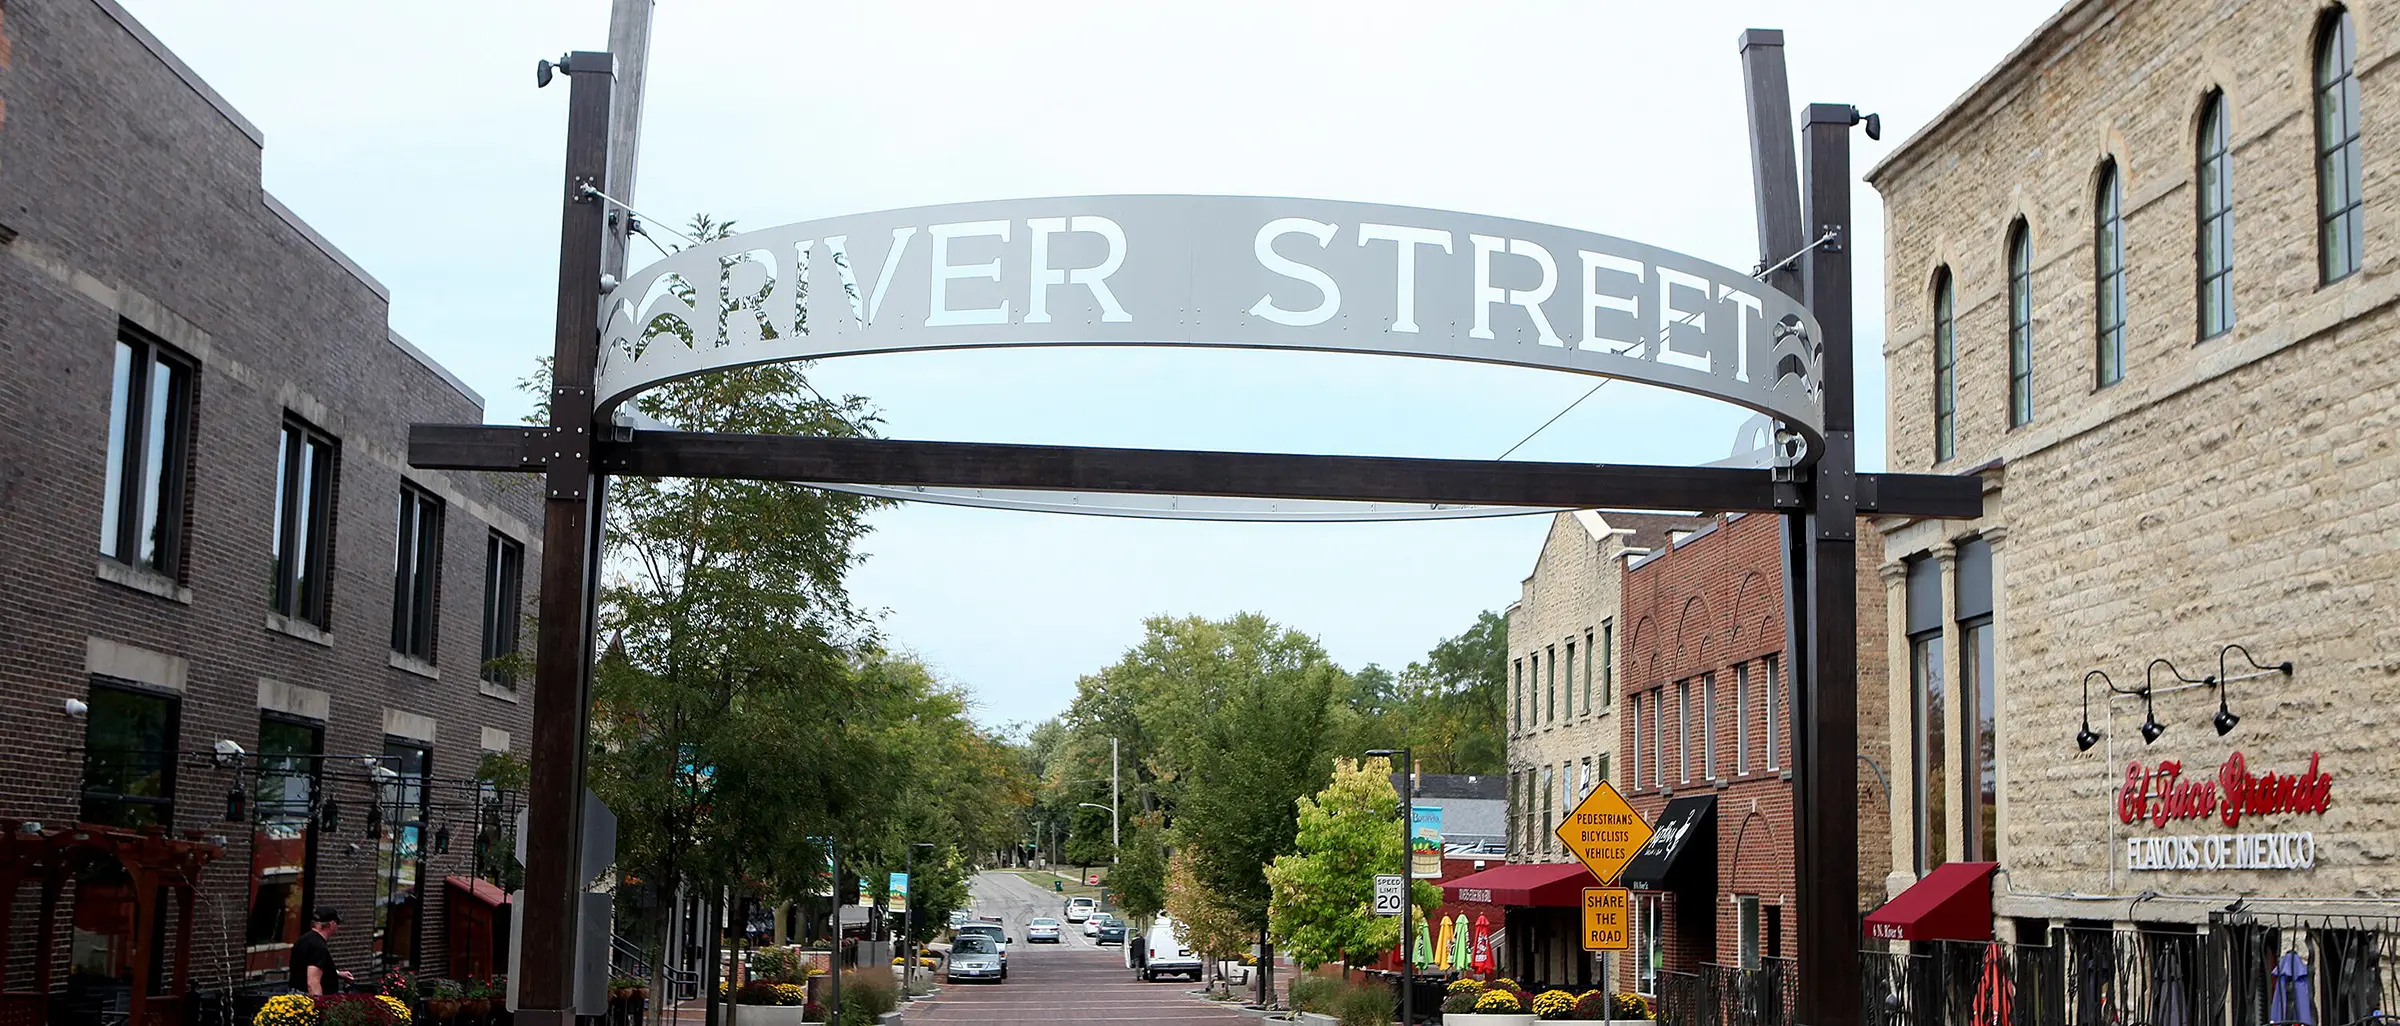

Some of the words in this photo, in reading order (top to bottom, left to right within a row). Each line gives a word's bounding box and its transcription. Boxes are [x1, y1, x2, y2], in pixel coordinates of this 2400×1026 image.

[714, 214, 1134, 350] RIVER
[1248, 216, 1764, 384] STREET
[2118, 760, 2150, 825] El
[2152, 759, 2217, 829] Taco
[2219, 751, 2332, 828] Grande
[1577, 813, 1633, 825] PEDESTRIANS
[1581, 830, 1629, 842] BICYCLISTS
[1585, 847, 1625, 859] VEHICLES
[2127, 835, 2200, 870] FLAVORS
[2203, 834, 2231, 870] OF
[2235, 831, 2315, 870] MEXICO
[1377, 895, 1401, 909] 20
[1587, 895, 1625, 908] SHARE
[1596, 913, 1616, 925] THE
[1591, 930, 1622, 942] ROAD
